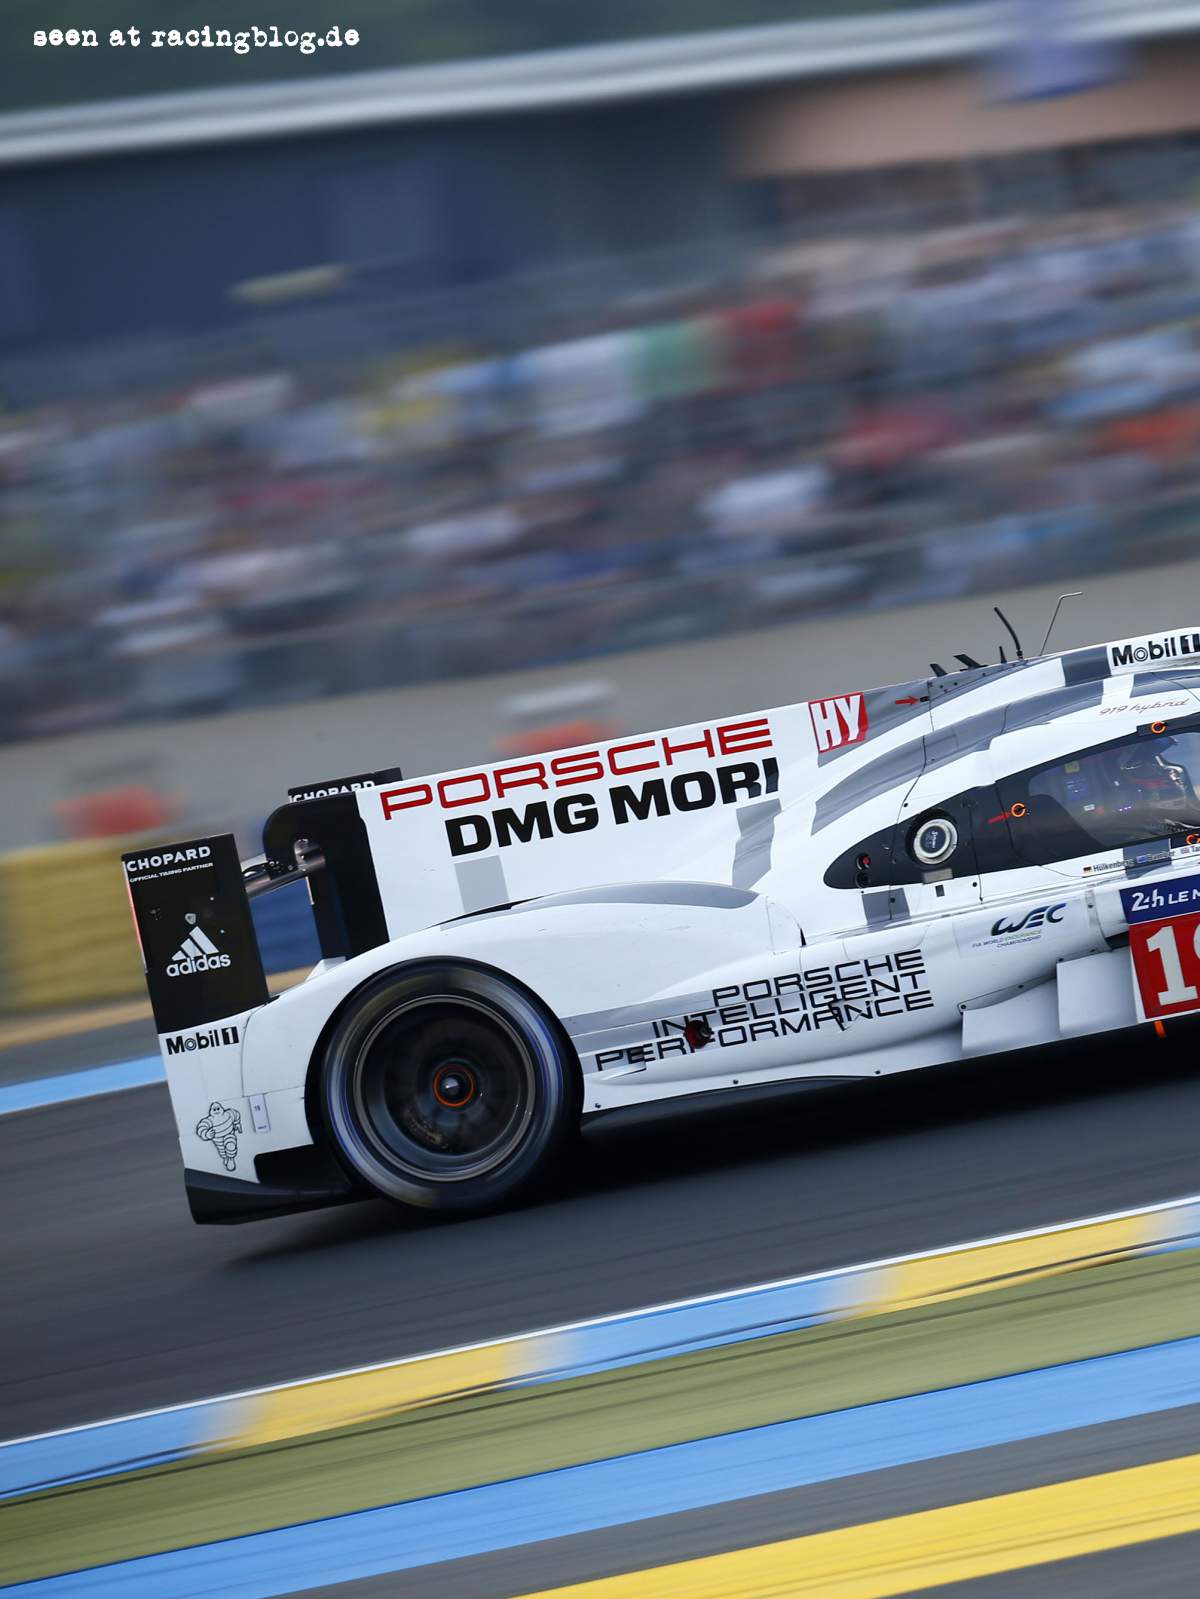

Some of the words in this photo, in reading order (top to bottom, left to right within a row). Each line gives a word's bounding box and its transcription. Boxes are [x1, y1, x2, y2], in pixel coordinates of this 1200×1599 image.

[1112, 637, 1177, 666] Mobil
[811, 694, 862, 751] HY
[380, 718, 773, 820] PORSCHE
[445, 793, 599, 857] DMG
[608, 757, 779, 825] MORI
[126, 846, 211, 872] CHOPARD
[129, 873, 159, 883] OFFICIAL
[182, 862, 213, 872] PARTNER
[1168, 891, 1189, 904] LE
[991, 903, 1067, 936] WEC
[166, 952, 231, 977] adidas
[712, 949, 925, 1006] PORSCHE
[652, 970, 926, 1039] INTELLIGENT
[166, 1029, 220, 1055] Mobil
[221, 1026, 240, 1045] 1
